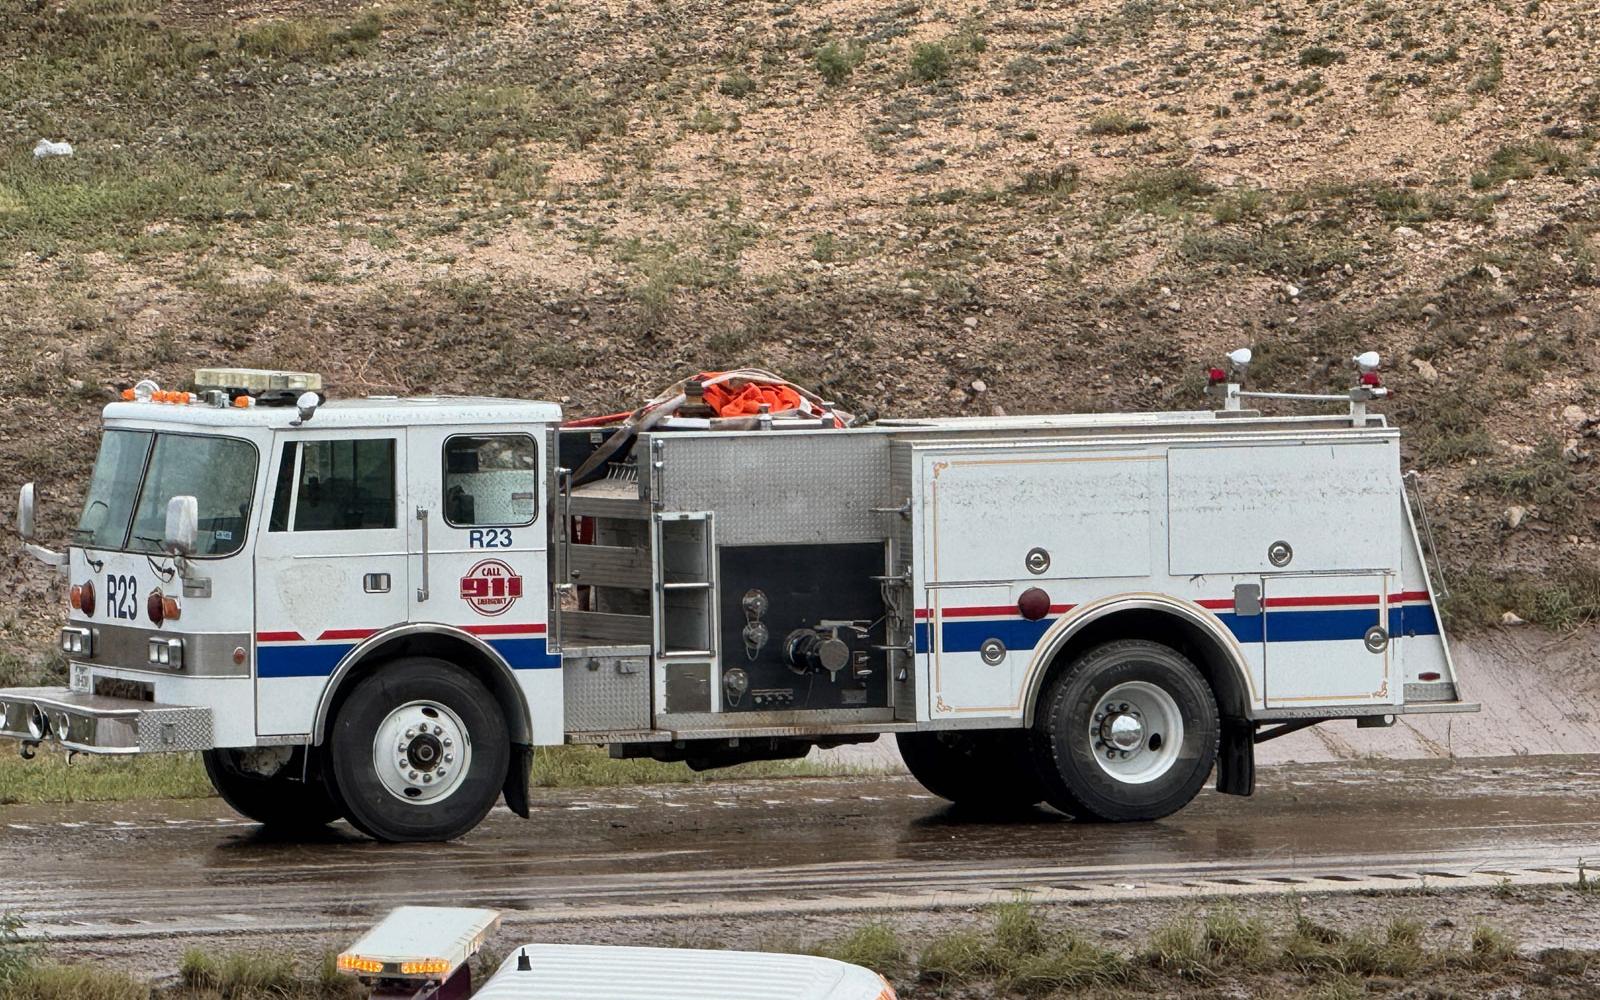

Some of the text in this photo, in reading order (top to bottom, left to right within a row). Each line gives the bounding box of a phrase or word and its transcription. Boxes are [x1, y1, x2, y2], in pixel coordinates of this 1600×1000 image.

[469, 529, 513, 548] R23
[481, 567, 501, 576] CALL
[106, 574, 138, 620] R23
